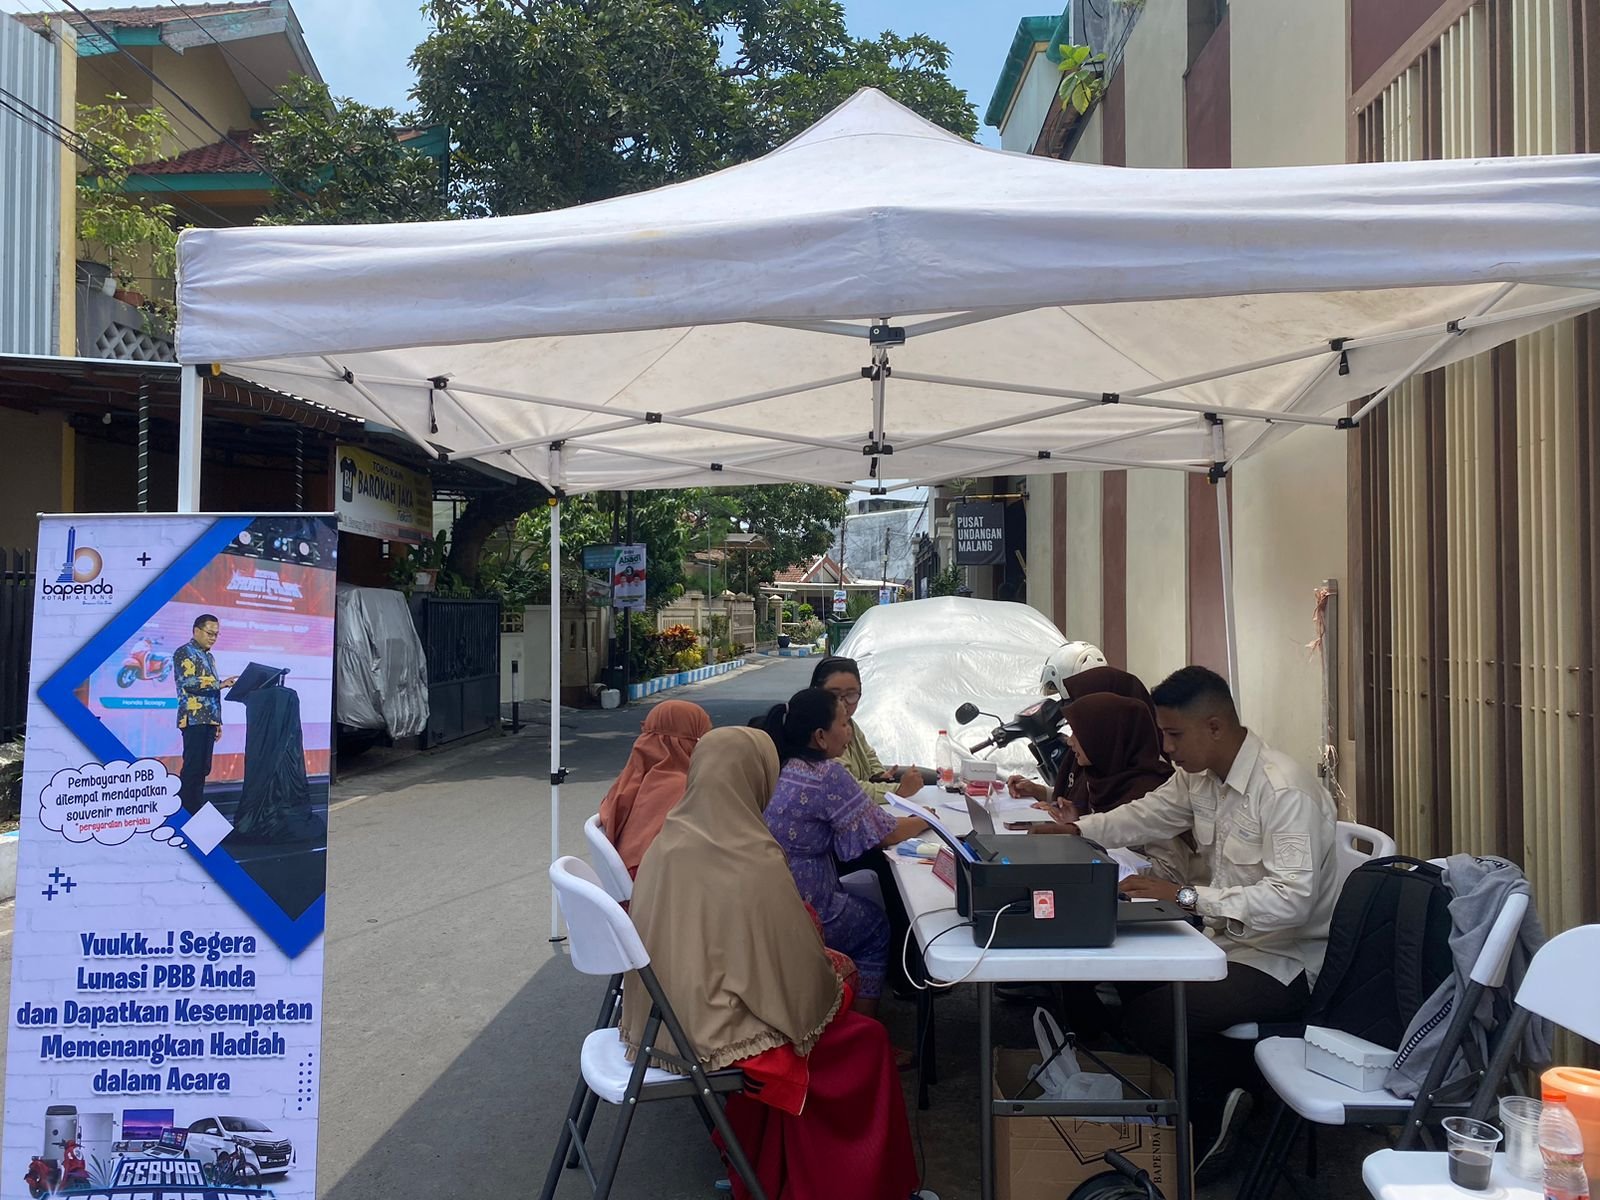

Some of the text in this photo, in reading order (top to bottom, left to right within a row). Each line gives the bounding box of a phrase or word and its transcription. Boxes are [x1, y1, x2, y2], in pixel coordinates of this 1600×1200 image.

[372, 460, 389, 476] TOKO
[358, 469, 396, 505] BAROKAH
[398, 484, 415, 509] JAYA
[957, 516, 984, 528] PUSAT
[958, 528, 1002, 540] UNDANGAN
[958, 541, 993, 552] MALANG
[42, 578, 114, 601] bapenda
[68, 769, 155, 790] Pembayaran PBB
[56, 784, 167, 807] ditempat mendapatkan
[66, 802, 158, 822] souvenir menarik
[124, 816, 151, 827] berlaku
[80, 930, 256, 961] Yuukk...! Segera
[77, 964, 256, 990] Lunasi PBB Anda
[17, 998, 313, 1029] dan Dapatkan Kesempatan
[40, 1031, 286, 1063] Memenangkan Hadiah
[93, 1067, 231, 1093] dalam Acara
[1152, 1132, 1162, 1184] BAPENDA
[116, 1160, 205, 1187] GEBYAR
